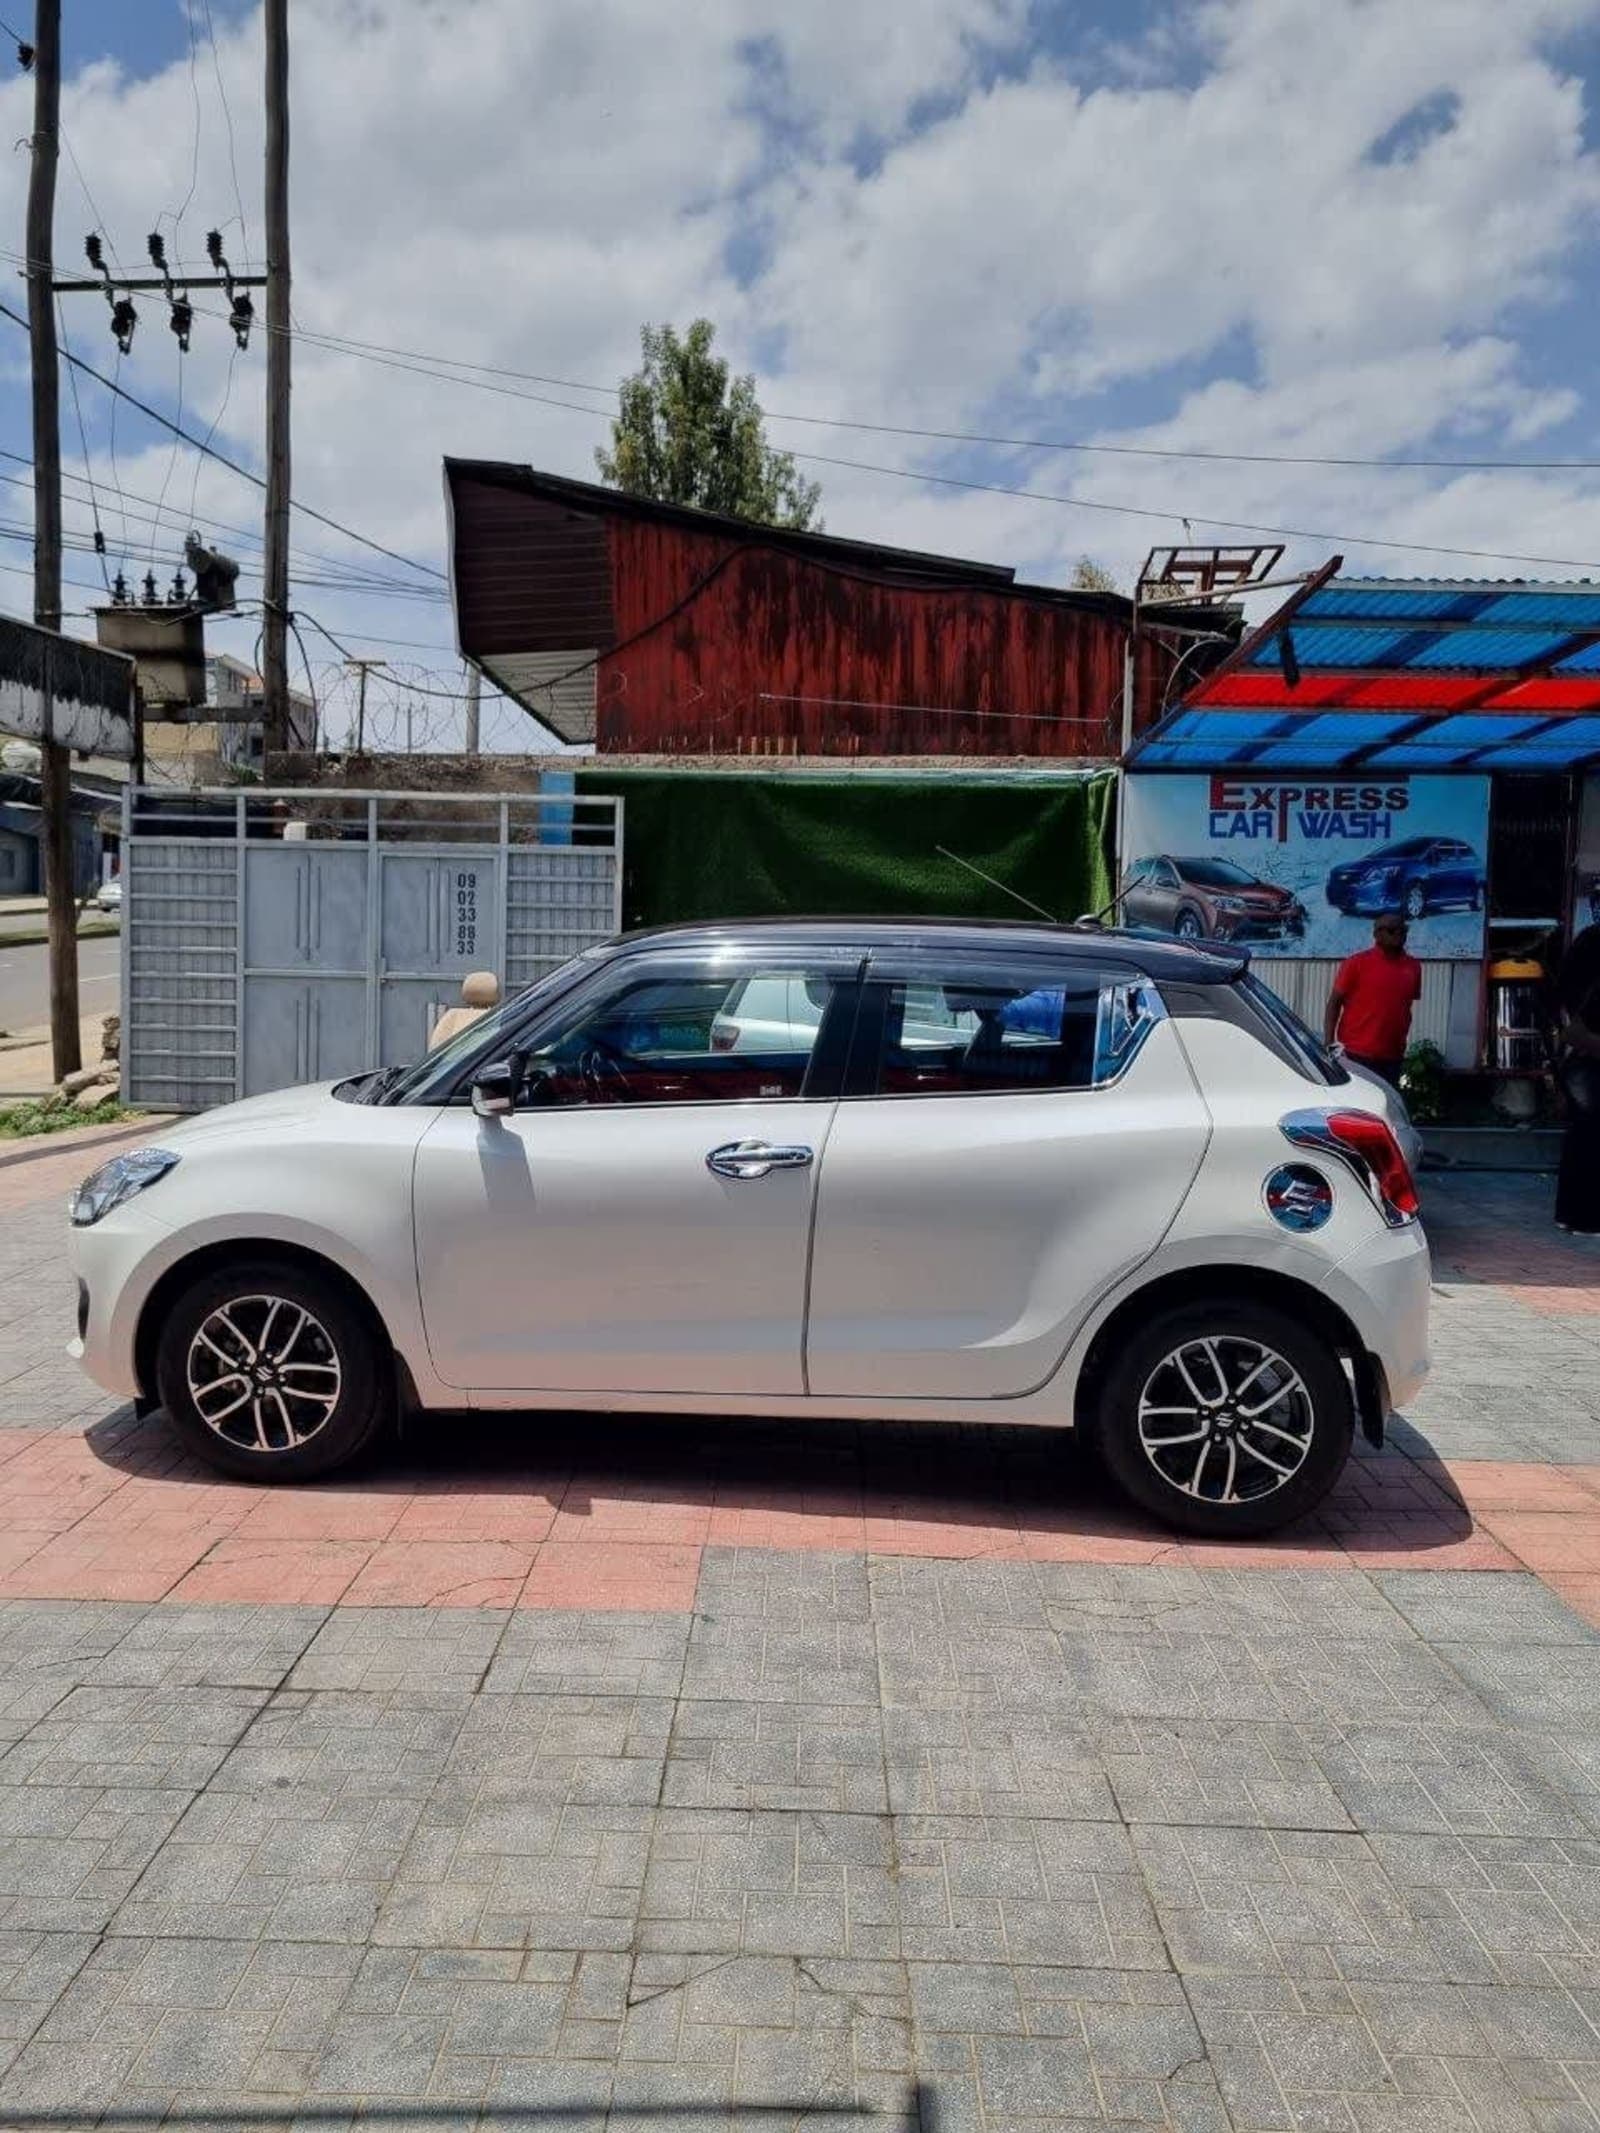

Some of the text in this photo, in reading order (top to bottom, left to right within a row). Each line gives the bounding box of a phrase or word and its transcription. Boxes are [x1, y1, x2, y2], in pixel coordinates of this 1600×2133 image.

[1209, 775, 1410, 815] EXPRESS
[1209, 811, 1391, 839] CAR WASH
[458, 873, 476, 888] 09
[458, 890, 476, 905] 02
[458, 907, 476, 922] 33
[457, 940, 475, 955] 33
